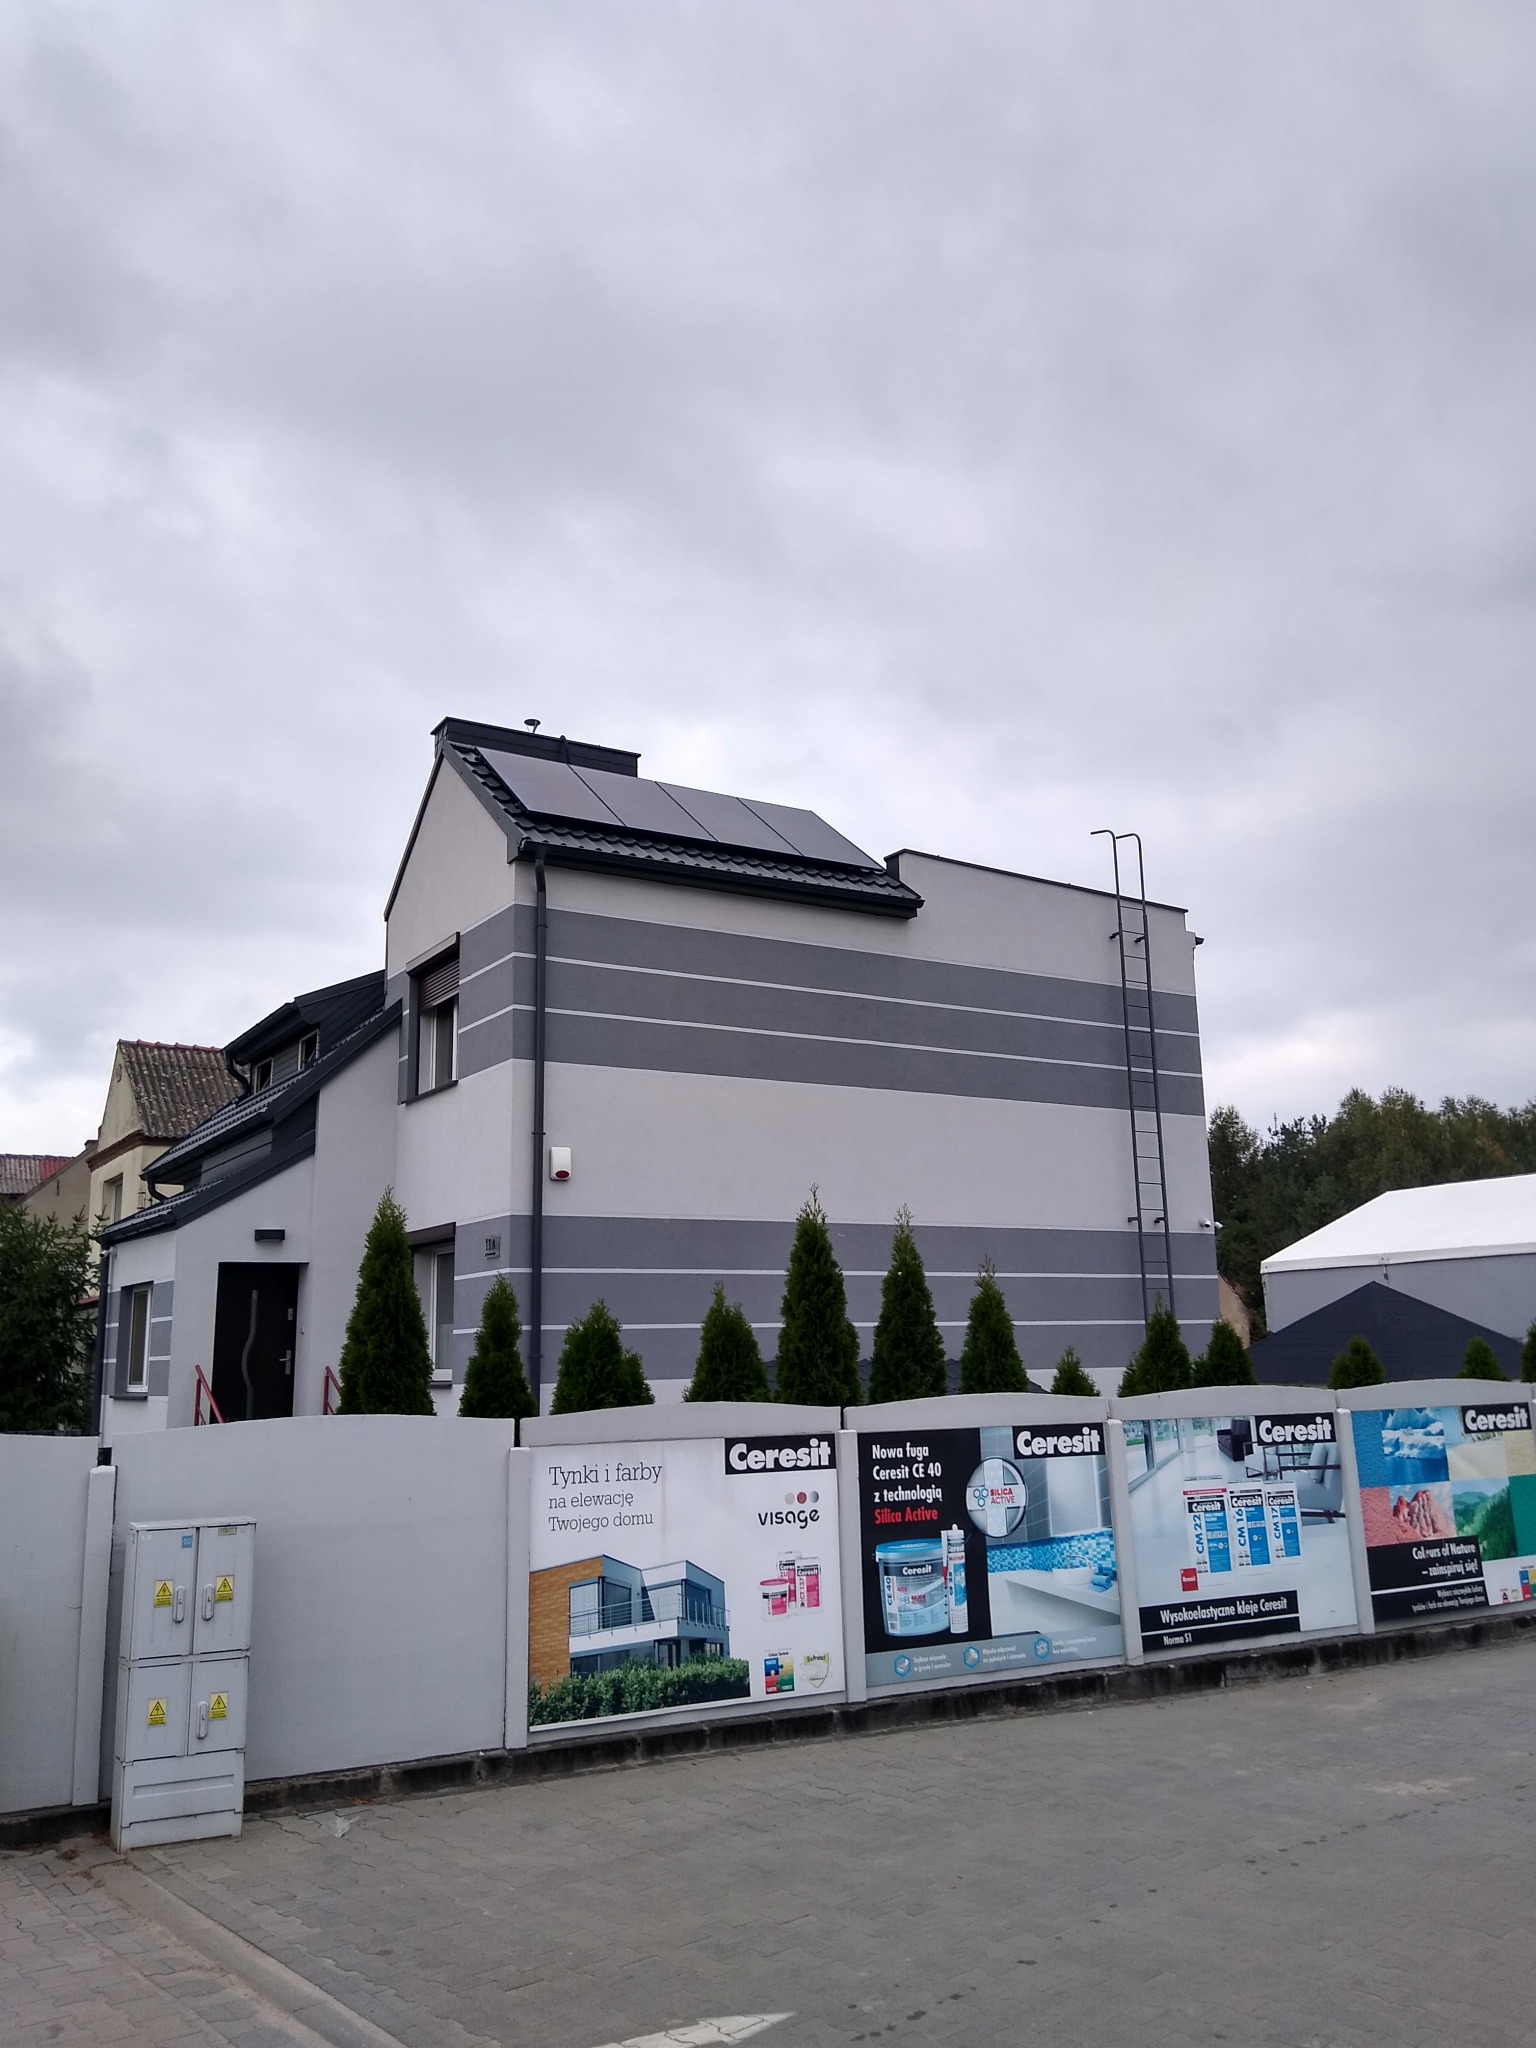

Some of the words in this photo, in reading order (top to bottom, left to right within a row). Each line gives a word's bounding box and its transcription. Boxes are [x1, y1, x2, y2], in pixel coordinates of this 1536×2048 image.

[1465, 1406, 1529, 1432] Ceresit
[1258, 1416, 1332, 1443] Ceresit
[1017, 1426, 1100, 1456] Ceresit
[729, 1438, 831, 1471] Ceresit
[872, 1444, 903, 1460] Nowa
[905, 1442, 929, 1462] fuga
[549, 1464, 599, 1489] Tynki
[604, 1463, 610, 1482] i
[615, 1462, 662, 1484] farby
[873, 1463, 910, 1481] Ceresit
[912, 1463, 925, 1479] CE
[927, 1462, 942, 1478] 40
[548, 1496, 566, 1509] na
[570, 1491, 634, 1508] elewację
[874, 1492, 880, 1502] z
[883, 1484, 943, 1503] technologią
[990, 1488, 1013, 1496] SILICA
[991, 1496, 1015, 1504] ACTIVE
[1232, 1495, 1262, 1507] Ceresit
[1268, 1495, 1294, 1506] Ceresit
[874, 1508, 901, 1525] Silica
[905, 1505, 938, 1522] Active
[1191, 1501, 1221, 1512] Ceresit
[1271, 1507, 1279, 1519] 17
[548, 1514, 609, 1532] Twojego
[612, 1512, 653, 1527] domu
[757, 1508, 820, 1529] visage
[1193, 1514, 1203, 1531] 22
[1235, 1509, 1244, 1523] 16
[1237, 1526, 1246, 1547] CM
[1273, 1521, 1281, 1539] CM
[1195, 1533, 1205, 1554] CM
[1442, 1543, 1450, 1556] of
[1450, 1543, 1476, 1556] Nature
[902, 1565, 932, 1576] Ceresit
[1428, 1560, 1465, 1576] zainspiruj
[1465, 1558, 1479, 1574] się!
[885, 1577, 892, 1591] 40
[886, 1593, 893, 1606] CE
[1160, 1604, 1236, 1626] Wysokoelastyczne
[1237, 1598, 1259, 1618] kleje
[1260, 1595, 1288, 1613] Ceresit
[1163, 1634, 1183, 1646] Norma
[1184, 1632, 1193, 1644] S1
